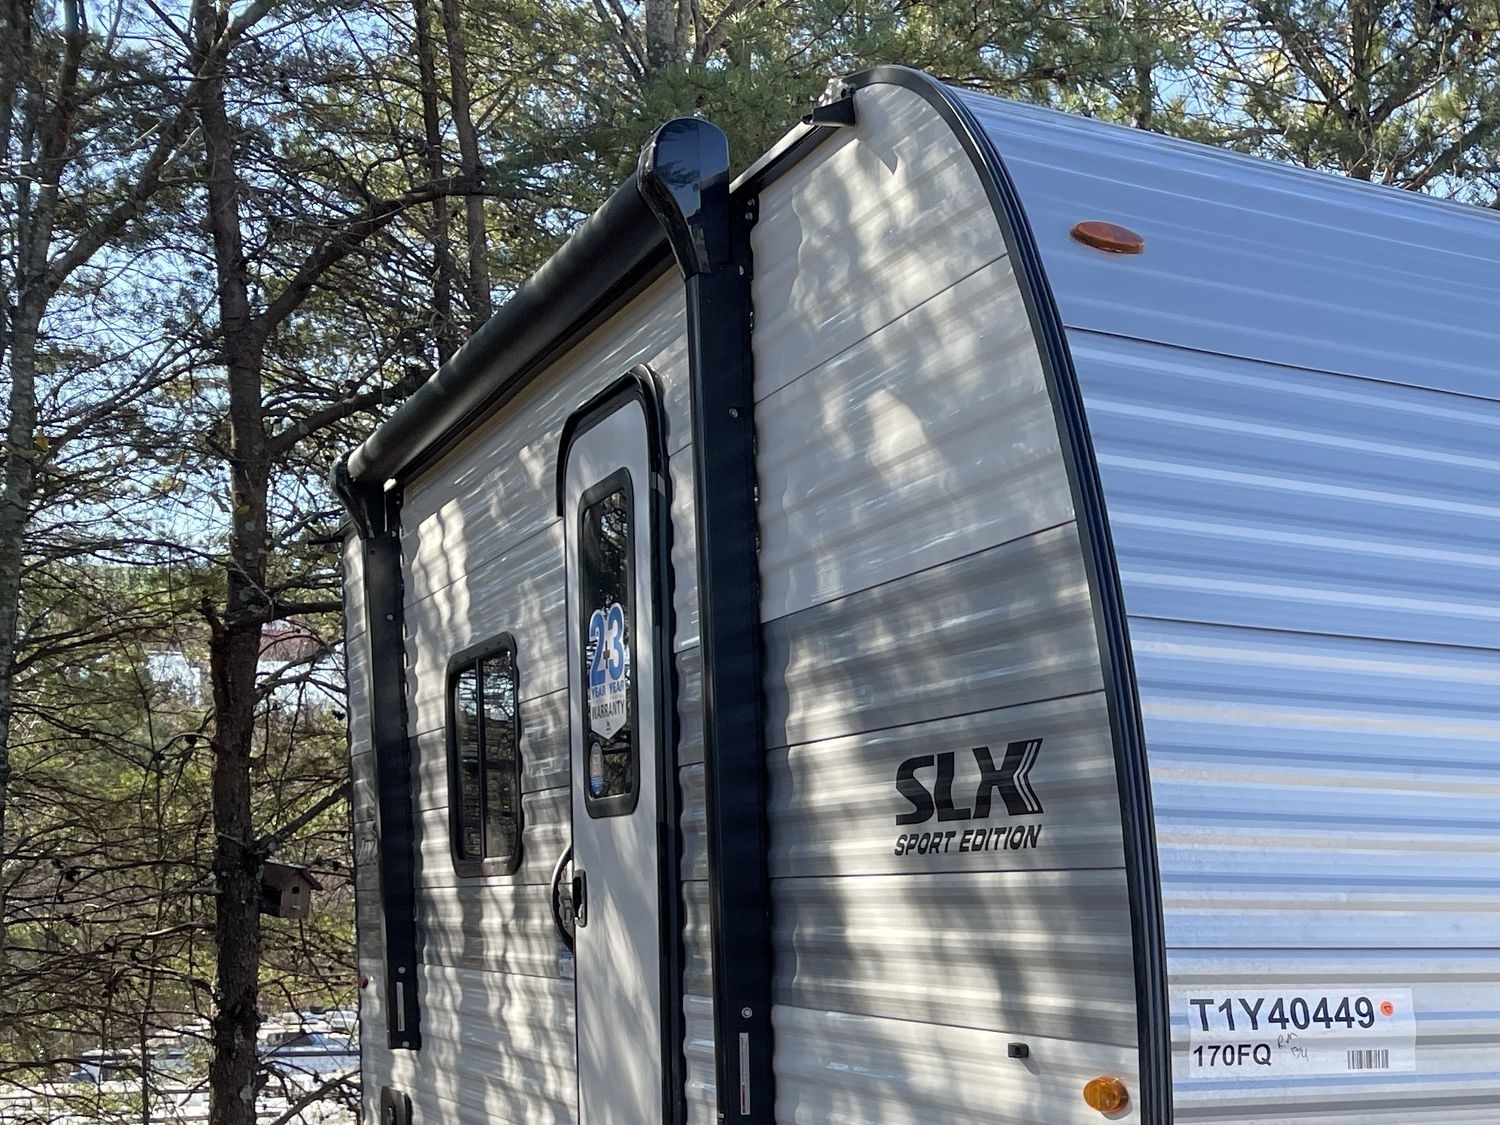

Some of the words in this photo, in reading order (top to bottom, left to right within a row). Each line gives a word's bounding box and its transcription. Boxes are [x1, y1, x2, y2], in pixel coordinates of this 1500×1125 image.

[592, 685, 606, 699] YEAR
[609, 680, 625, 695] YEAR
[591, 699, 625, 720] WARRANTY
[895, 737, 1044, 826] SLX
[894, 831, 957, 856] SPORT
[959, 824, 1043, 853] EDITION
[1189, 996, 1375, 1032] T1Y40449
[1193, 1043, 1272, 1066] 170FQ
